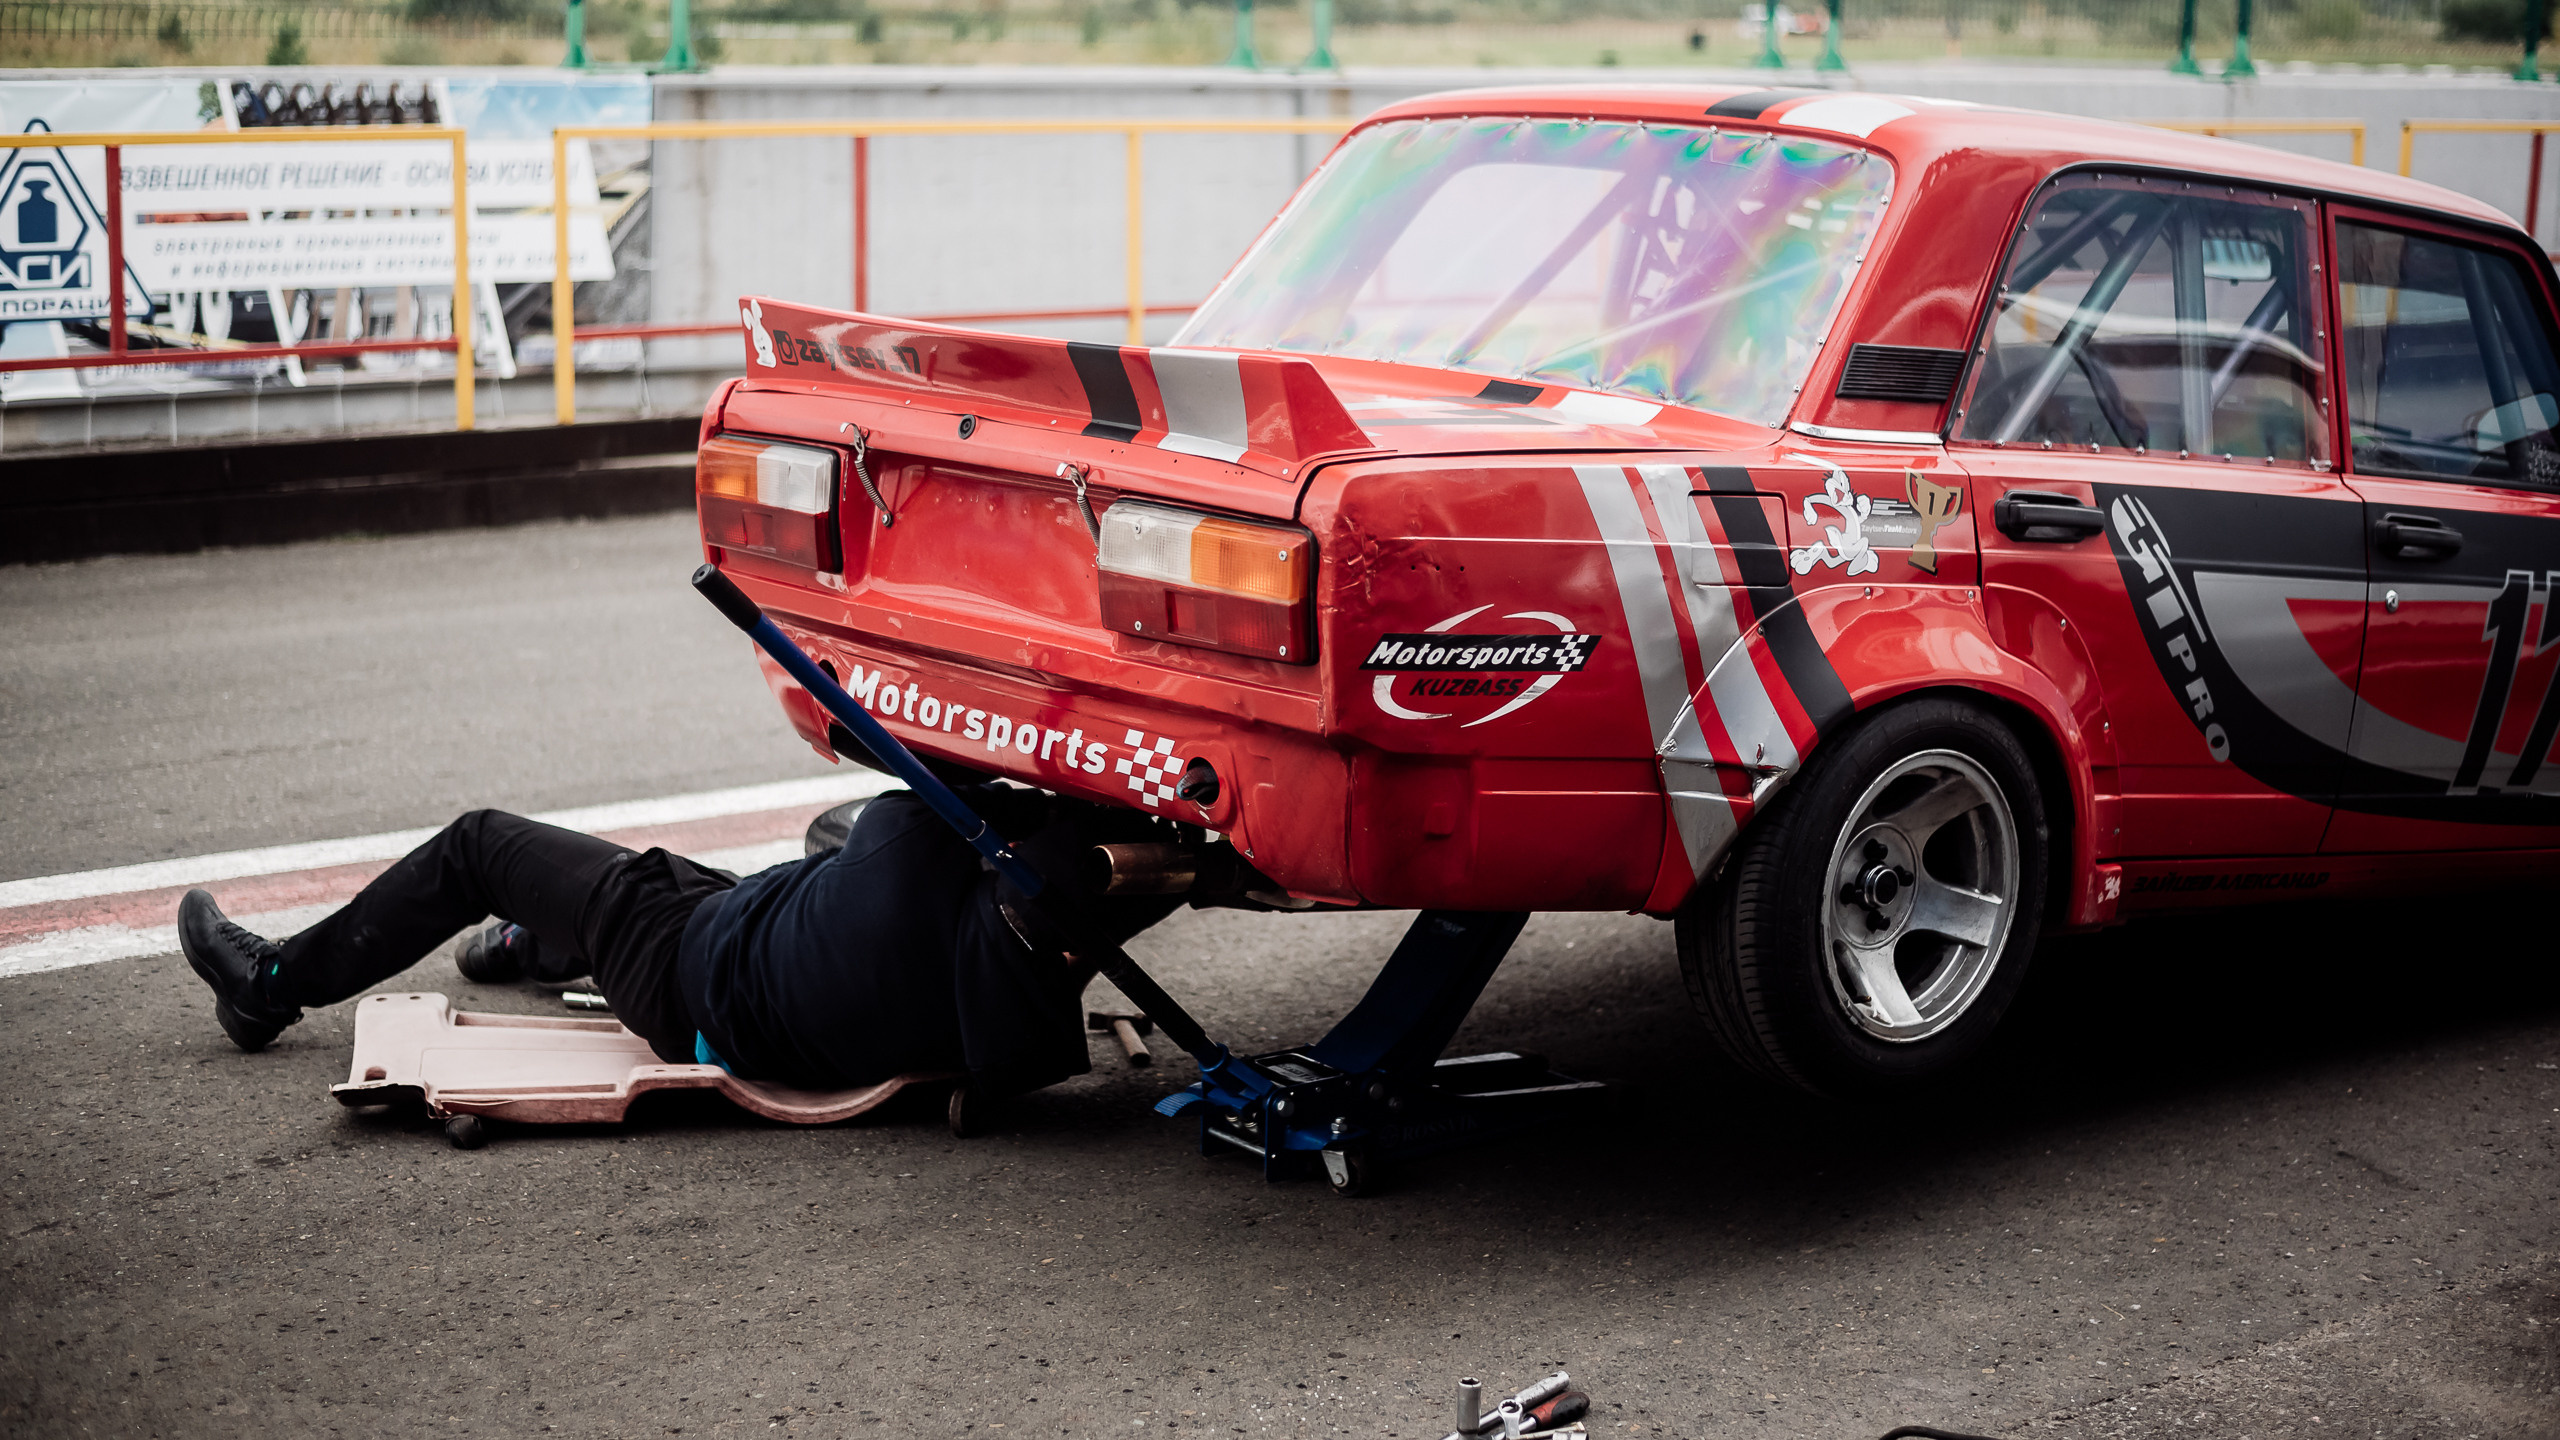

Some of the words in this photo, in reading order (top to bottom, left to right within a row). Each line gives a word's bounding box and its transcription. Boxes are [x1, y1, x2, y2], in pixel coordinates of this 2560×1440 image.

[281, 160, 383, 190] РЕШЕНИЕ
[405, 159, 490, 187] ОСНВА
[795, 337, 921, 375] zaytsev_17
[1367, 641, 1551, 669] Motorsports
[1409, 678, 1525, 697] KUZBASS
[2166, 633, 2230, 763] PRO
[847, 664, 1109, 775] Motorsports
[2131, 871, 2214, 893] ЗАЙЦЕВ
[2212, 871, 2330, 891] АЛЕКСАНДР
